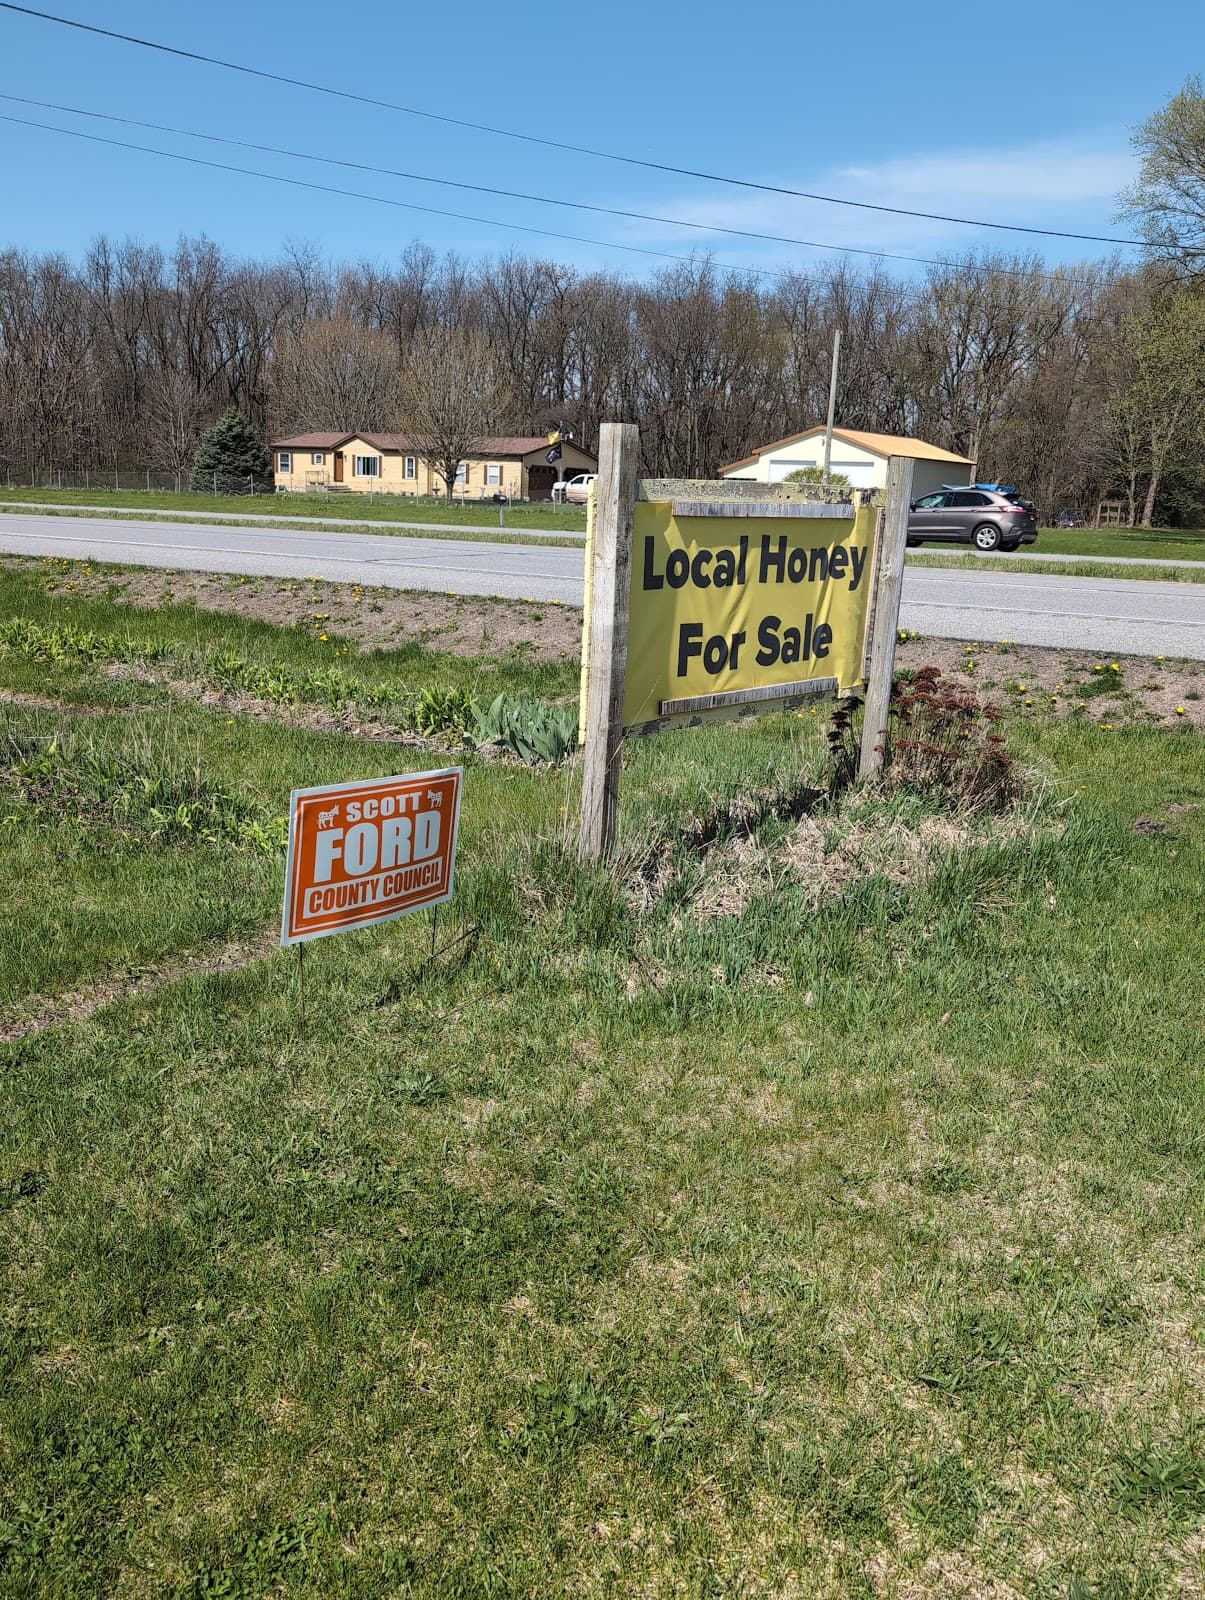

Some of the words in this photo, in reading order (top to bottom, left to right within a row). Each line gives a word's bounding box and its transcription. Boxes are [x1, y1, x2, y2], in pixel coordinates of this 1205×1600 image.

[643, 535, 749, 591] Local
[759, 534, 868, 591] Honey
[677, 622, 746, 677] For
[755, 613, 833, 667] Sale
[346, 791, 422, 822] SCOTT
[314, 810, 442, 883] FORD
[309, 878, 381, 914] COUNTY
[383, 861, 440, 898] COUNCIL
